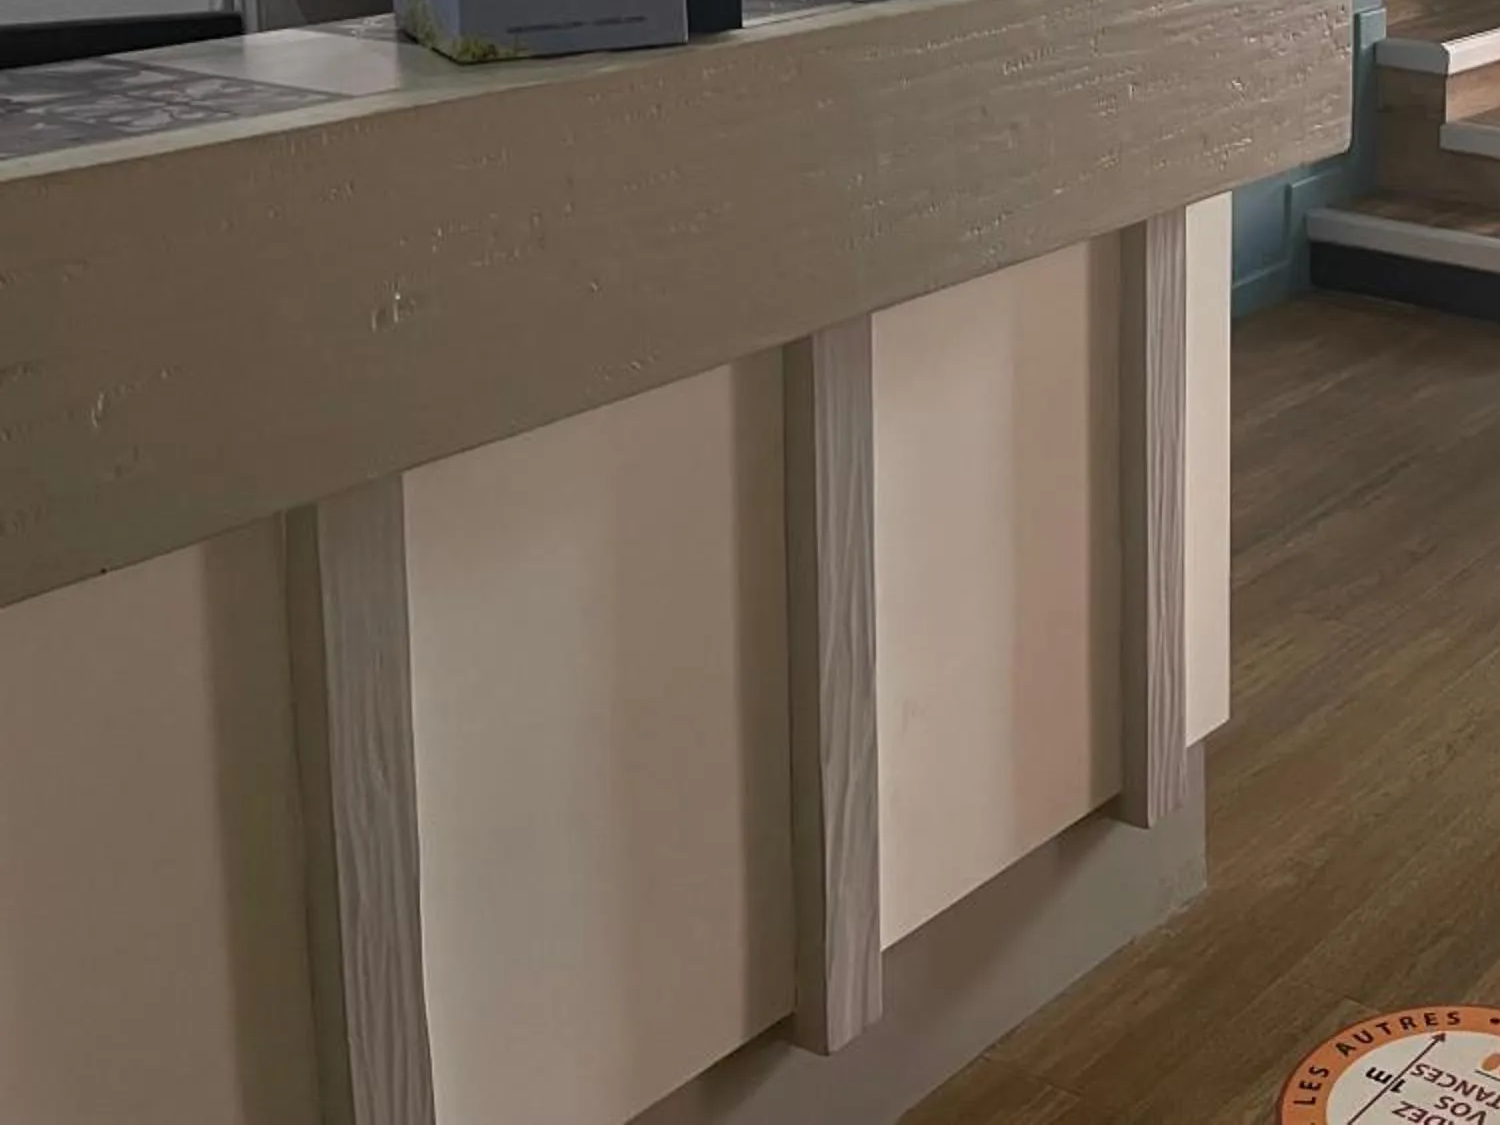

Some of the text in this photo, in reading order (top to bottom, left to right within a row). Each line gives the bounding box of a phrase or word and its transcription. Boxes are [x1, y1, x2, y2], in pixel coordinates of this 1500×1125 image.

[1293, 1011, 1461, 1106] LES AUTRES
[1391, 1100, 1455, 1125] DEZ
[1433, 1095, 1487, 1125] VOS
